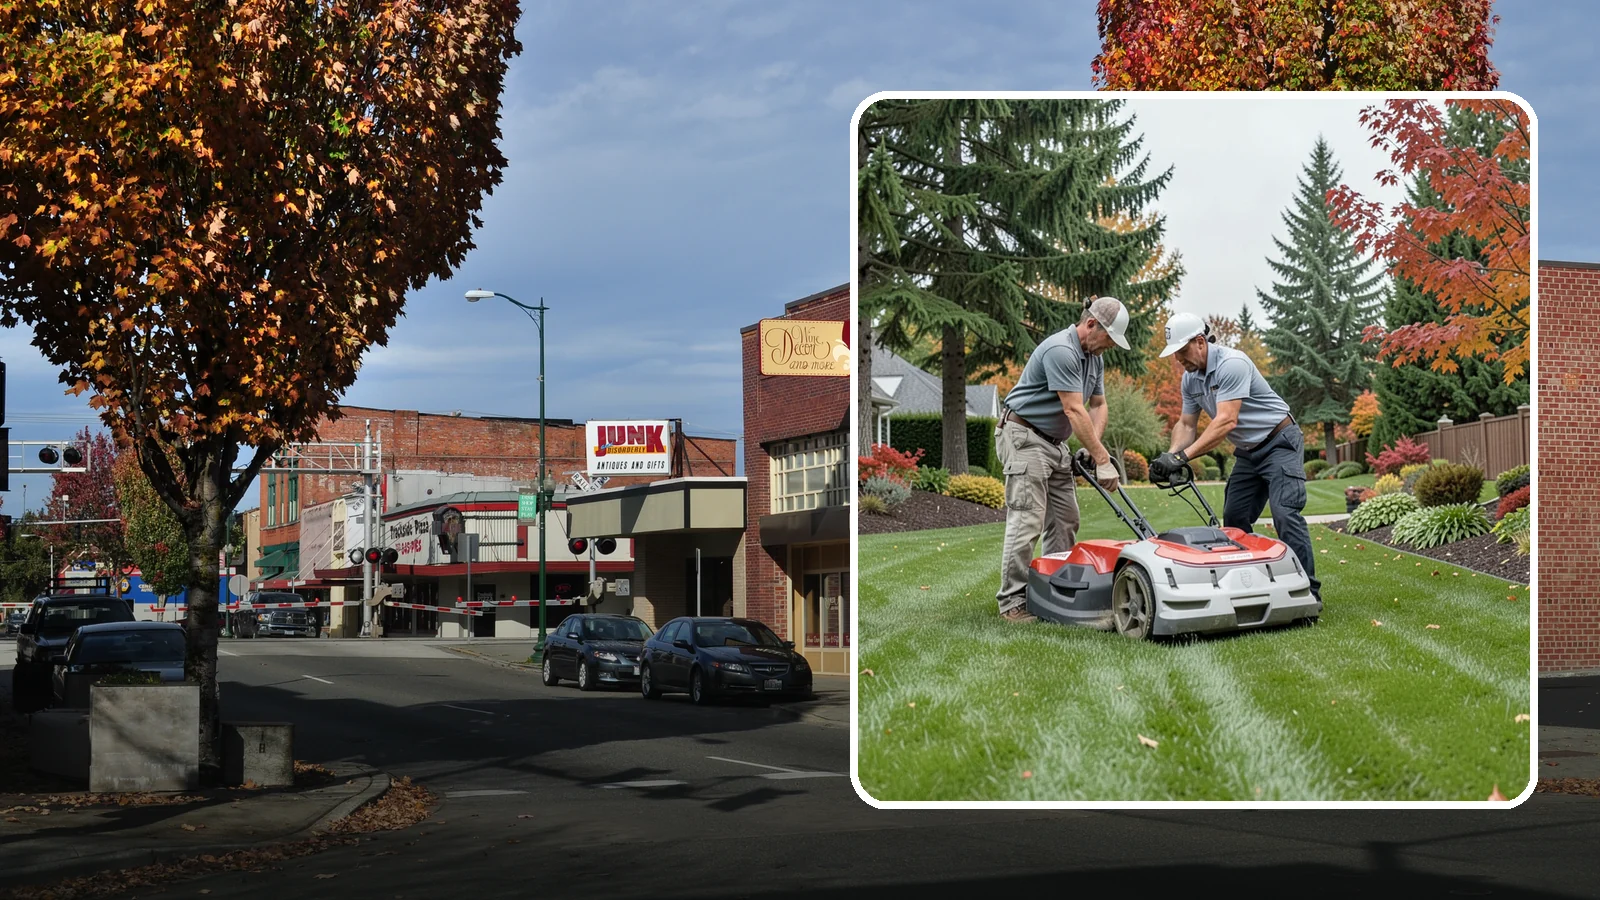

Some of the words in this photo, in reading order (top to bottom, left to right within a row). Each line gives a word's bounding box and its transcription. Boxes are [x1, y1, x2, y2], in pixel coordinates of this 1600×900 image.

[595, 425, 665, 457] JUNK
[597, 461, 628, 470] ANTIQUES
[631, 461, 643, 470] AND
[647, 461, 665, 470] GIFTS
[390, 520, 413, 540] Trackside
[414, 519, 429, 535] Pizza
